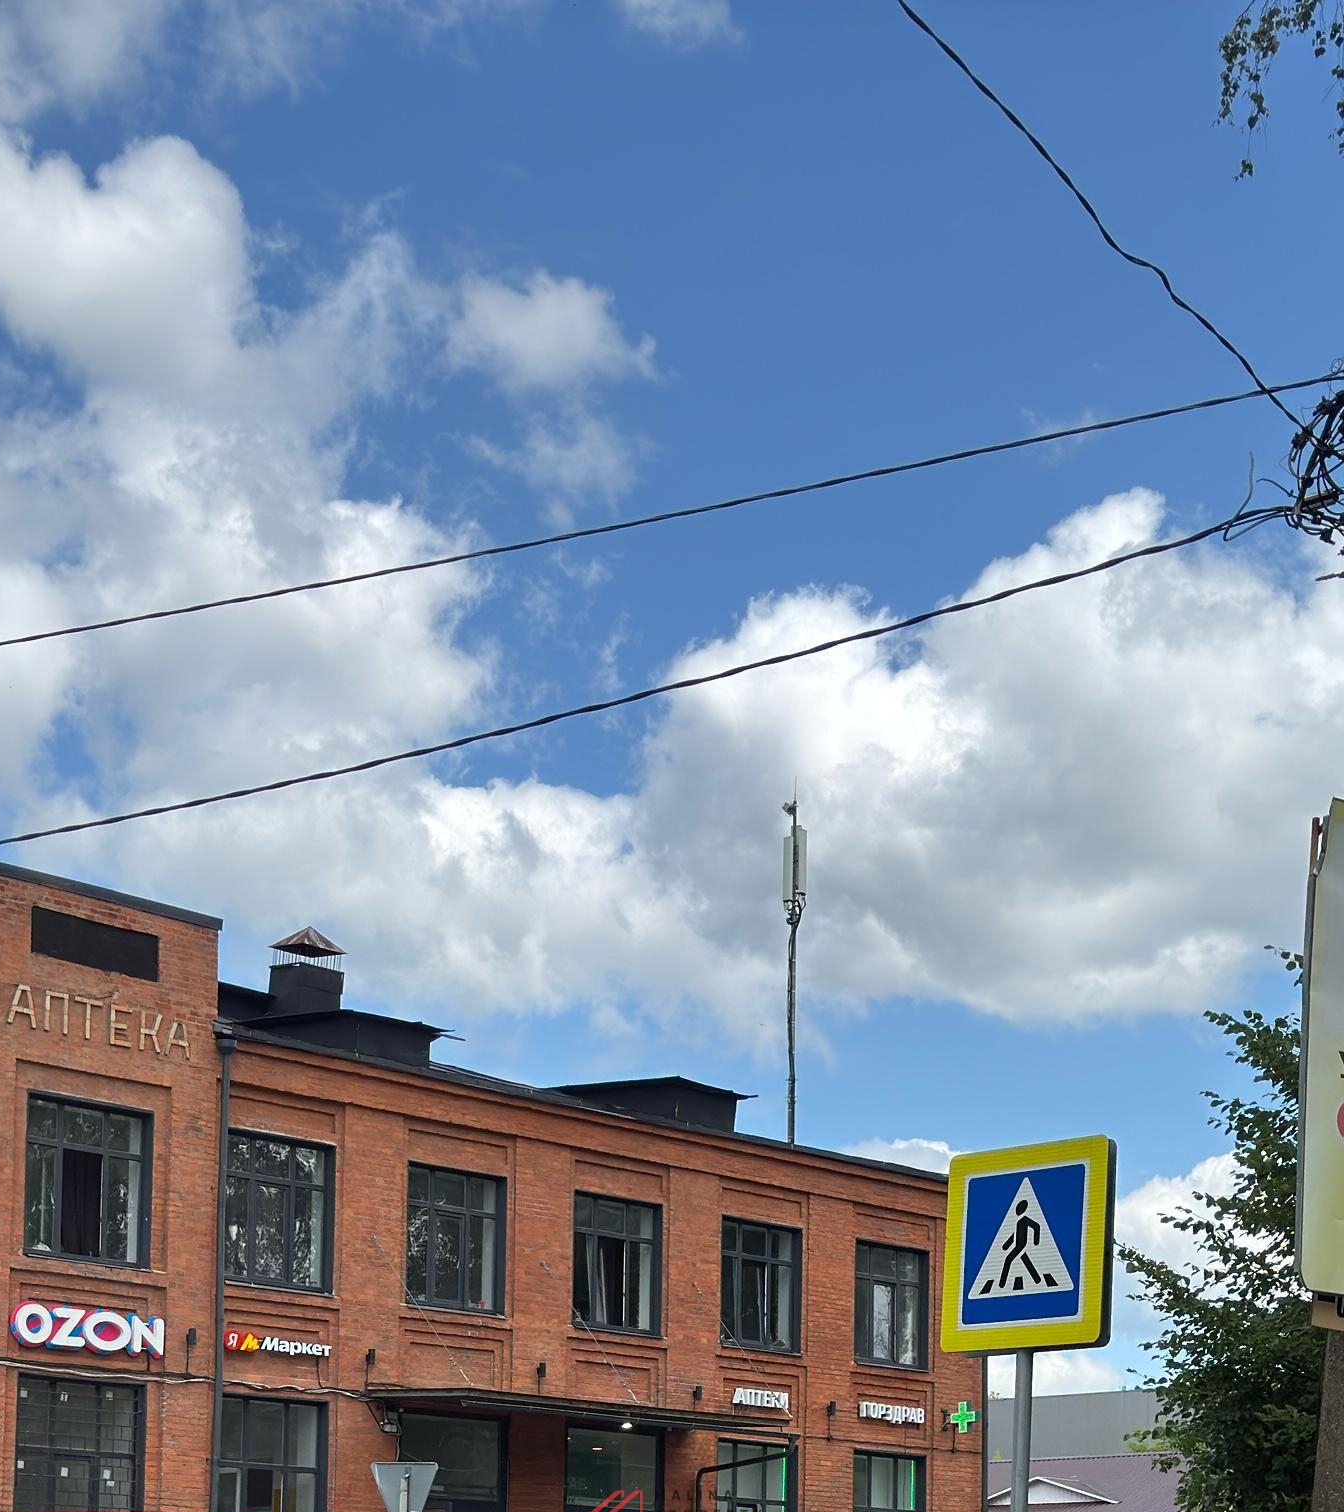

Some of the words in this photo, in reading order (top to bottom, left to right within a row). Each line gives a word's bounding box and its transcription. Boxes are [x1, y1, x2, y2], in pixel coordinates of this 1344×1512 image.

[6, 984, 191, 1060] АПТЕКА
[14, 1302, 165, 1357] OZON
[260, 1336, 332, 1357] Маркет
[733, 1387, 790, 1409] АПТЕКИ
[860, 1401, 926, 1424] ГОРЗДРАВ
